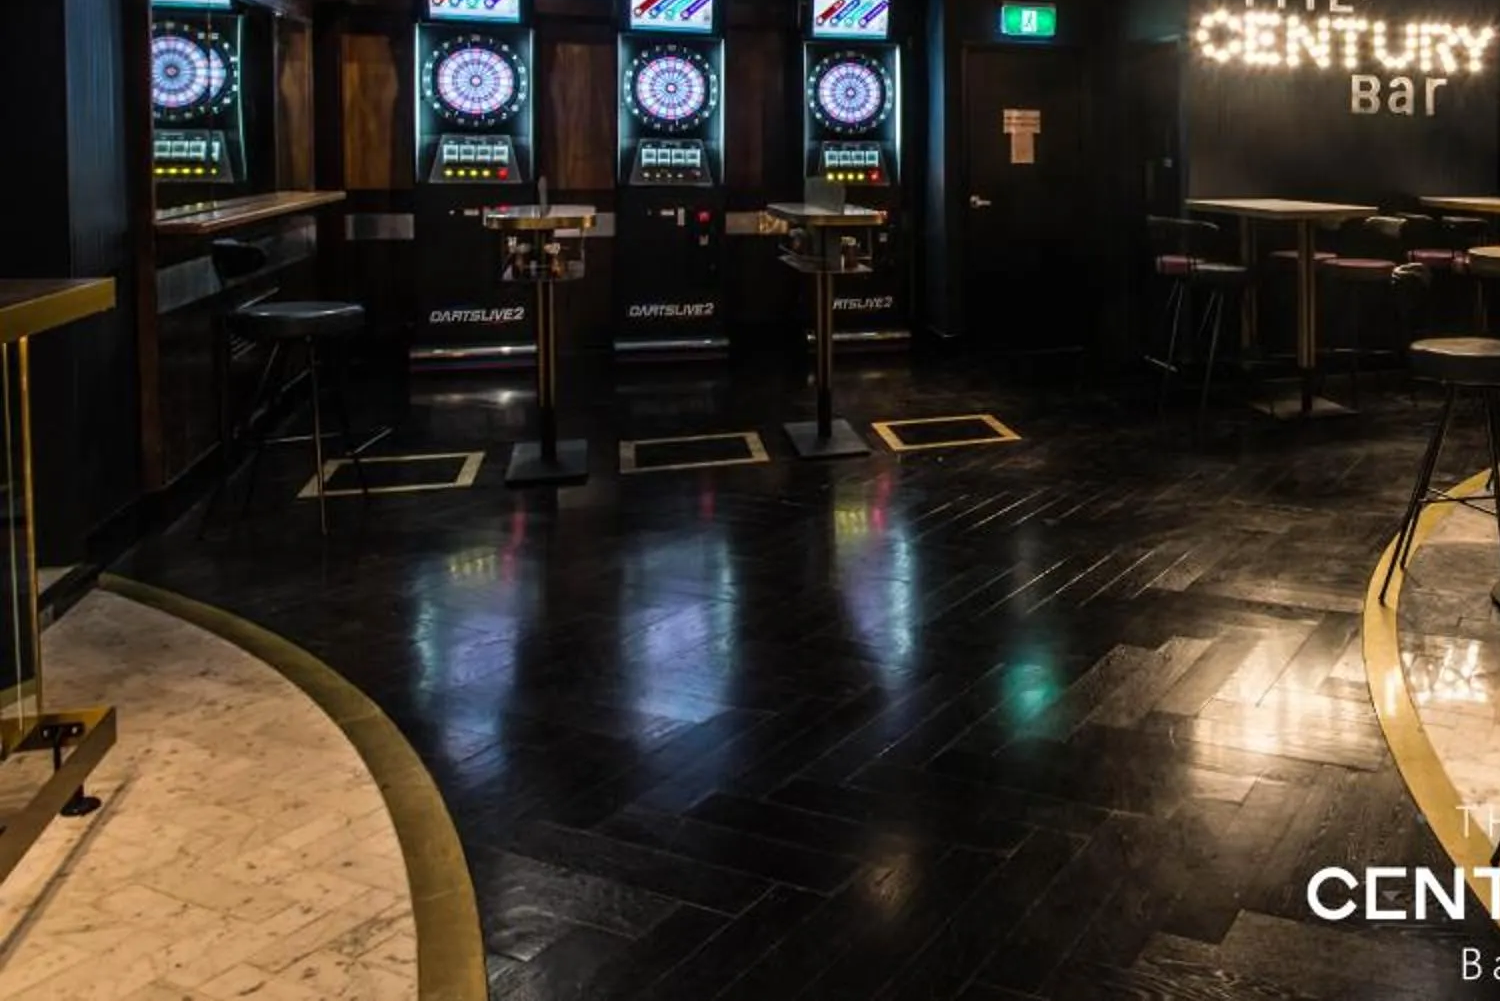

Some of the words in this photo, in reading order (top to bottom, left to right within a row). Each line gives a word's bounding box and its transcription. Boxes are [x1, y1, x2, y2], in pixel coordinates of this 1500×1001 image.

[1197, 9, 1495, 73] CENTURY
[1351, 74, 1448, 116] Bar
[429, 306, 525, 322] DARTSLIVE2
